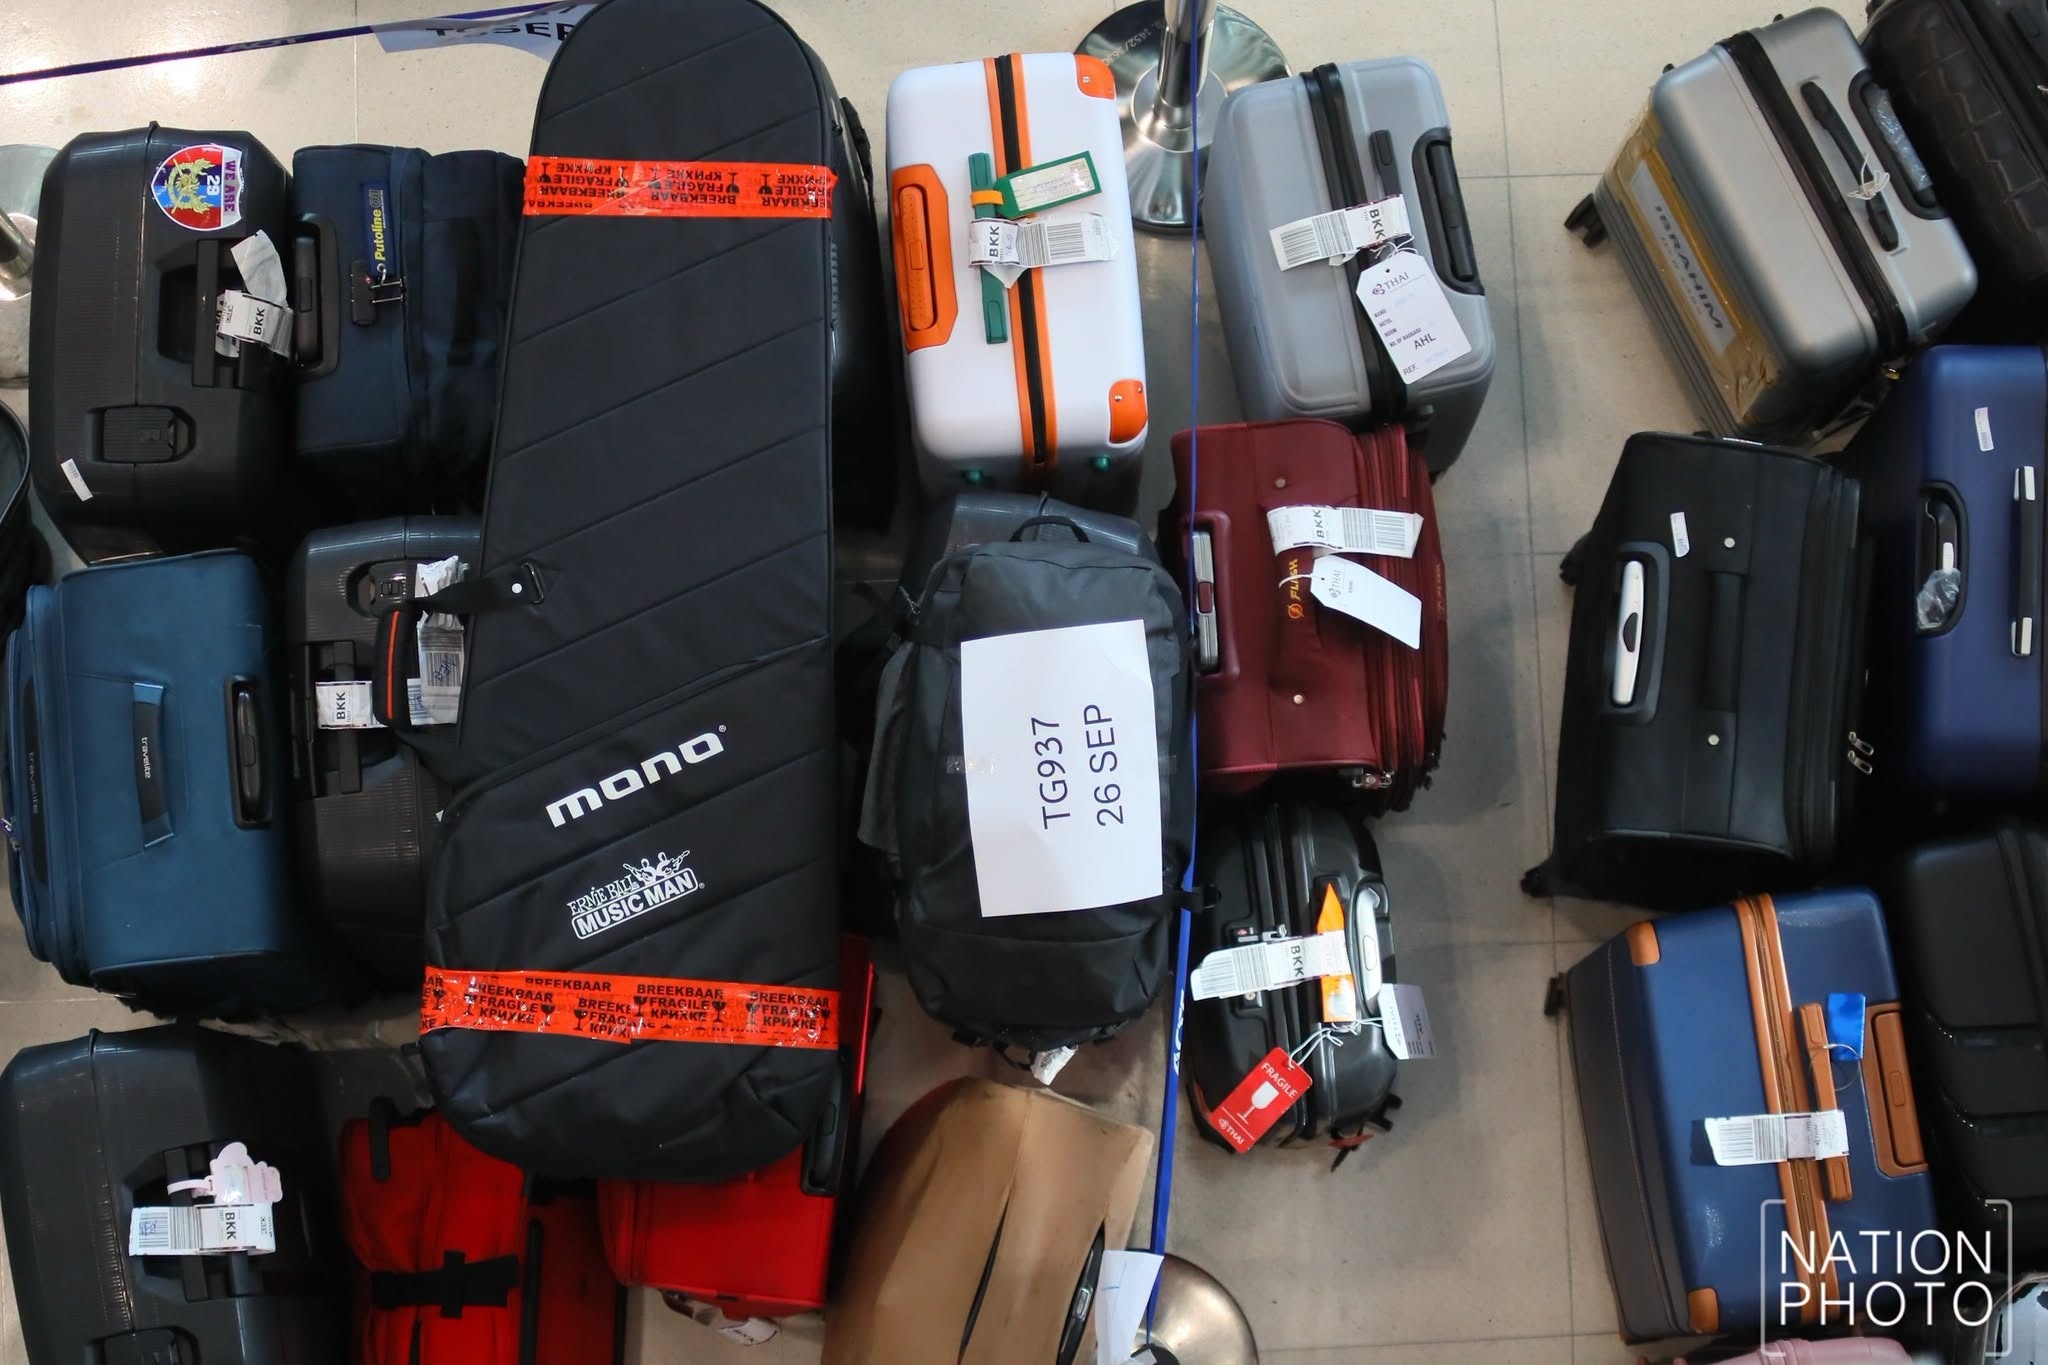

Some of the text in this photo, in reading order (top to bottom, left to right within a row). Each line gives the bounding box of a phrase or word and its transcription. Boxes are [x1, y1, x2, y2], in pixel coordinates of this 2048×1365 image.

[206, 175, 220, 196] 29
[224, 160, 236, 212] WE ARE
[554, 173, 613, 187] FRAGILE
[372, 208, 386, 261] Putoline
[1369, 208, 1386, 241] BKK
[989, 226, 1000, 258] BKK
[1385, 271, 1410, 290] THAI
[1656, 206, 1723, 329] IBRAHIM
[253, 307, 265, 335] BKK
[1413, 333, 1437, 350] AHL
[1313, 509, 1325, 538] BKK
[336, 691, 346, 720] BKK
[141, 737, 151, 779] travelite
[1083, 704, 1124, 826] 26 SEP
[1031, 717, 1071, 830] TG937
[605, 873, 640, 900] BALL
[576, 872, 694, 936] MUSIC MAN
[1290, 945, 1304, 977] BKK
[637, 984, 724, 1000] BREEKBAAR
[649, 997, 710, 1011] FRAGILE
[749, 991, 830, 1009] BREEKBAAR
[763, 1016, 817, 1031] КРИХКЕ
[1261, 1062, 1298, 1099] FRAGILE
[1226, 1125, 1245, 1146] THAI
[225, 1211, 237, 1241] BKK
